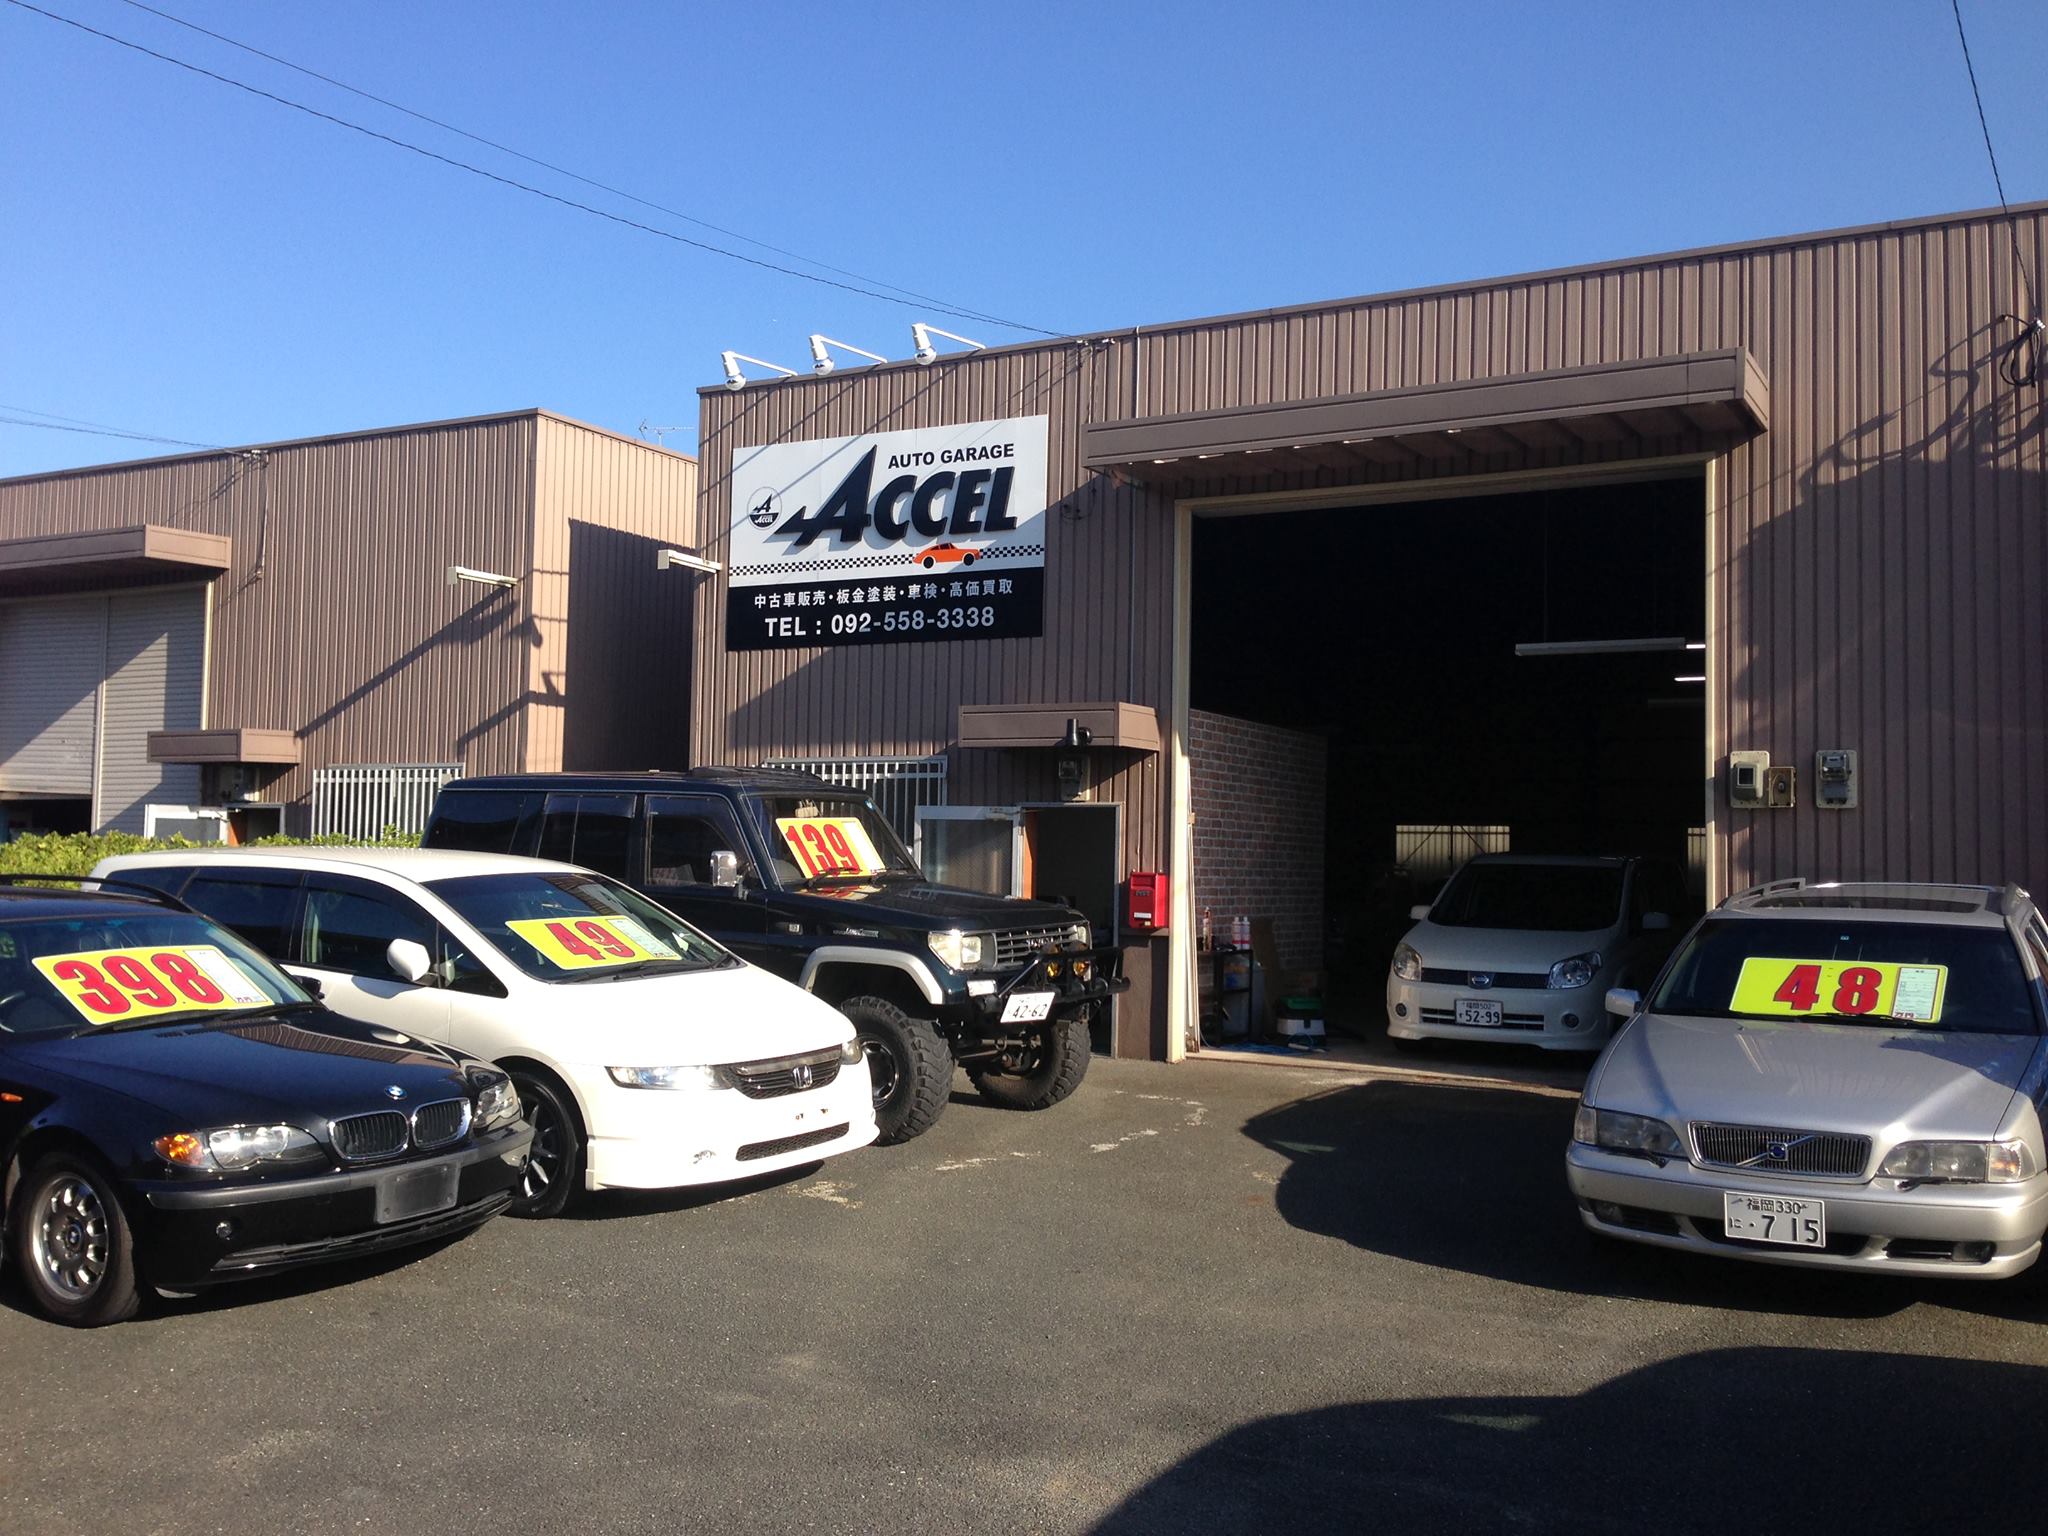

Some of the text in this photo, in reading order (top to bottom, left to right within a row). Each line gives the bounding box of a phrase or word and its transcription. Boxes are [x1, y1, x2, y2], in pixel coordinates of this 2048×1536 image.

[888, 443, 1015, 470] AUTO GARAGE
[774, 444, 1018, 546] ACCEL
[831, 606, 995, 635] 092-558-3338
[785, 823, 862, 878] 139
[544, 920, 636, 961] 49
[53, 952, 225, 1014] 398
[1773, 964, 1883, 1015] 48
[1465, 1009, 1500, 1024] 52-99
